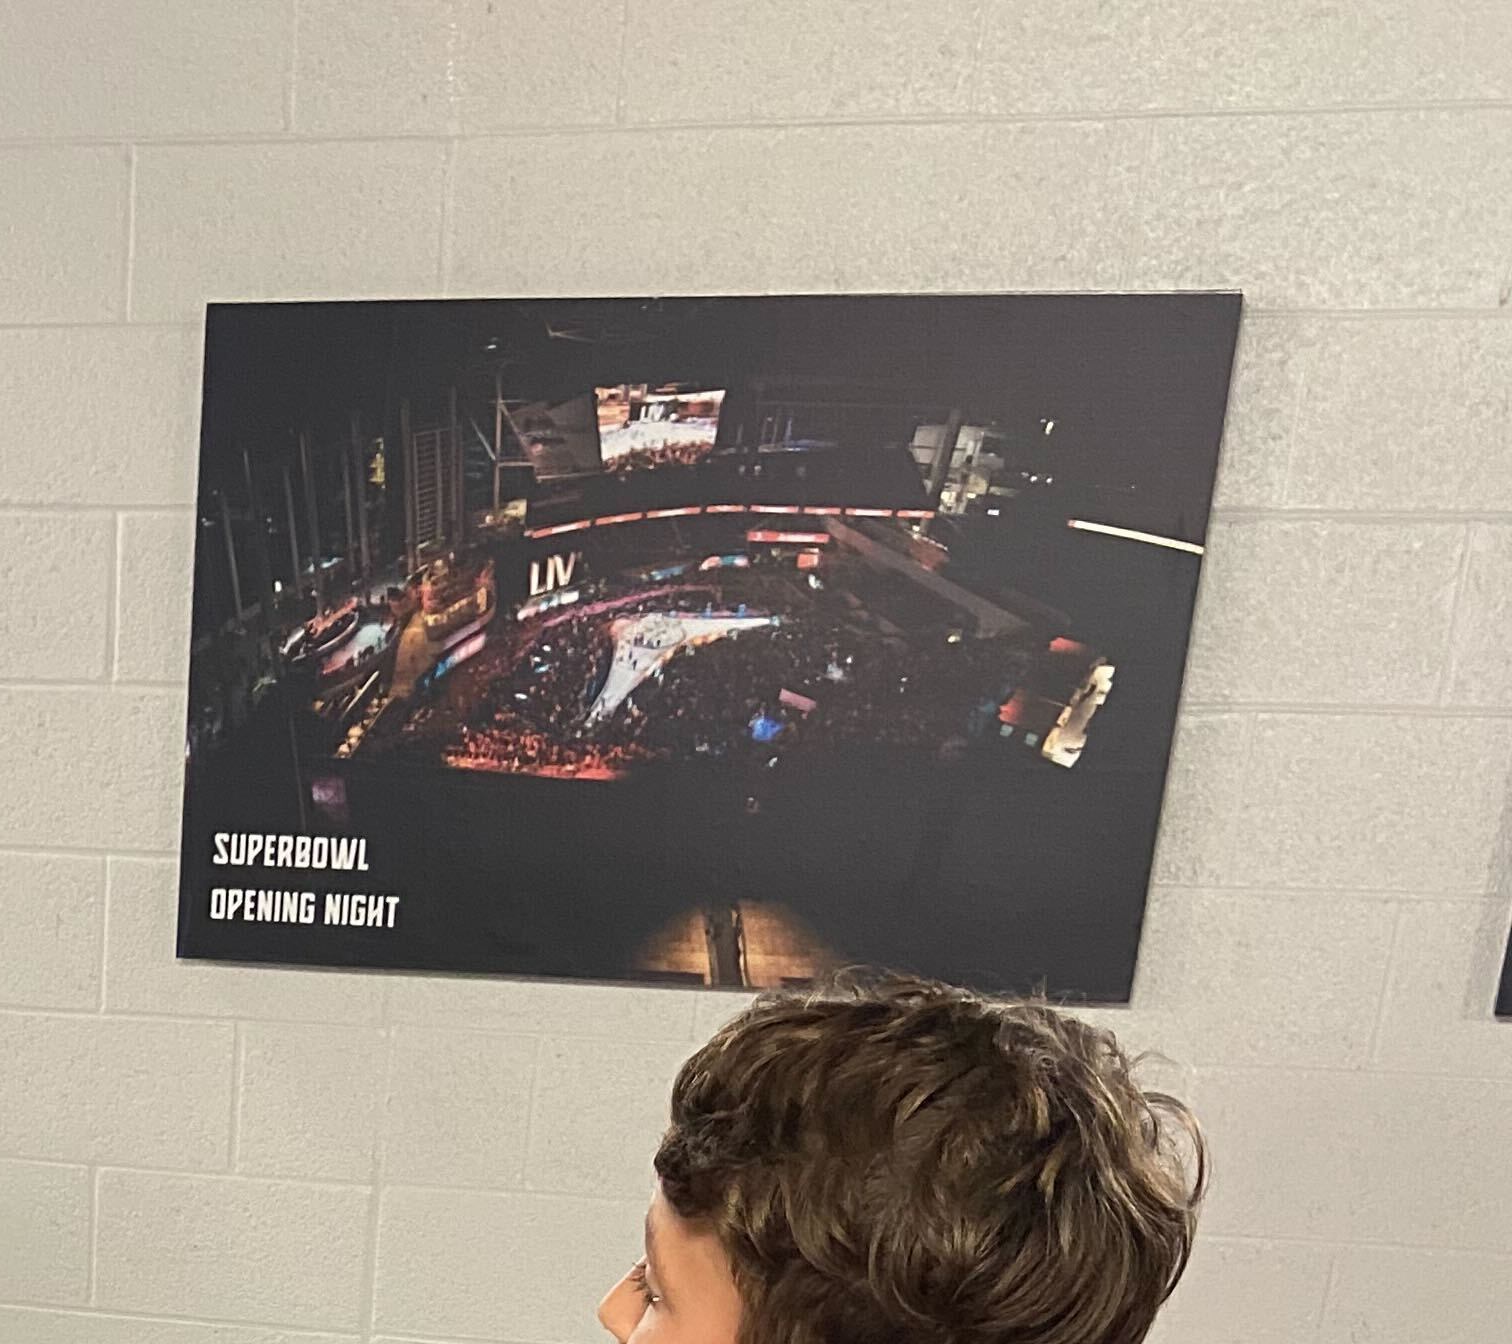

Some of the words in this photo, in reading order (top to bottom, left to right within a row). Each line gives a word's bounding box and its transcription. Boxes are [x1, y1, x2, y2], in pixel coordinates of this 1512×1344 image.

[529, 552, 577, 596] LIV
[212, 832, 370, 871] SUPERBOWL
[209, 887, 317, 925] OPENING
[323, 892, 401, 929] NIGHT
